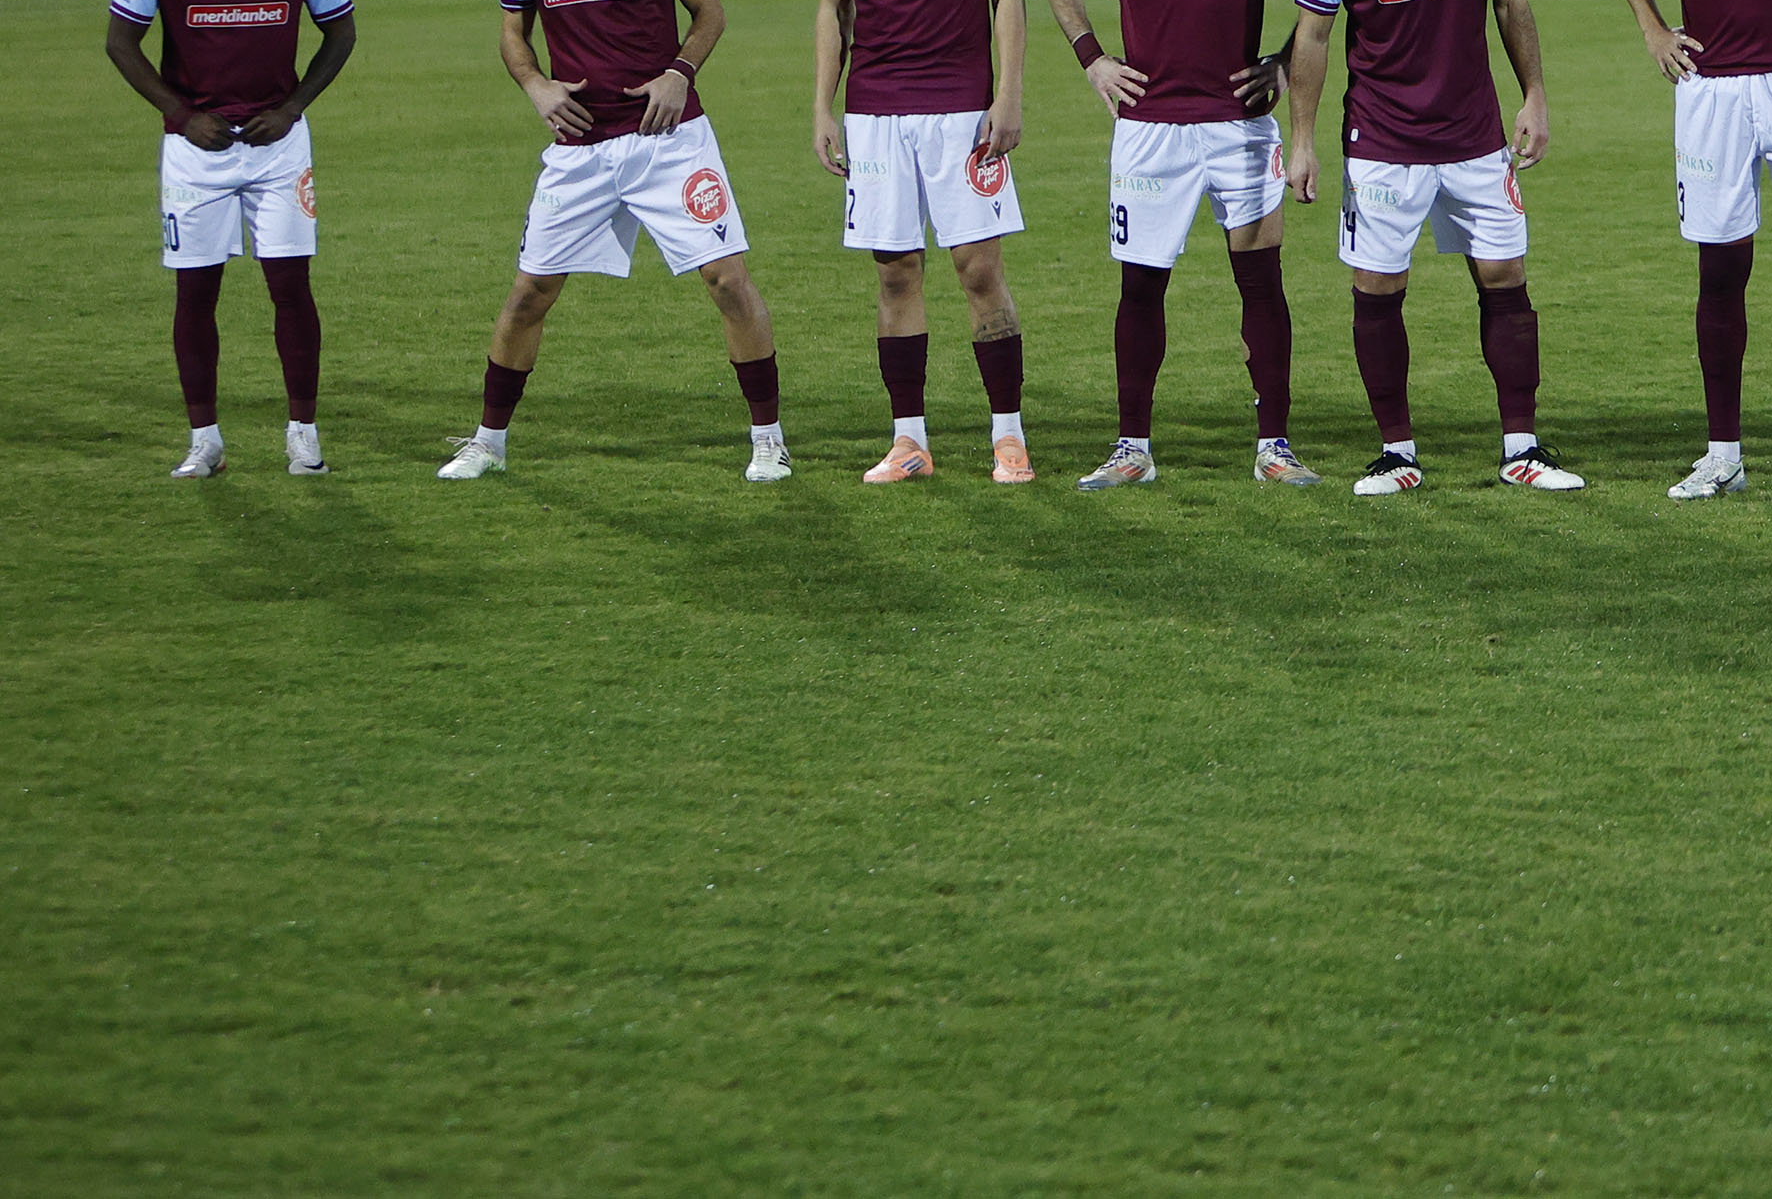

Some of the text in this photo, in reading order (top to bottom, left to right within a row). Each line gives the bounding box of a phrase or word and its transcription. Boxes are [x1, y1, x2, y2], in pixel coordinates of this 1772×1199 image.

[192, 7, 283, 24] meridianbet
[693, 188, 721, 212] Pizza
[702, 195, 722, 215] Hut
